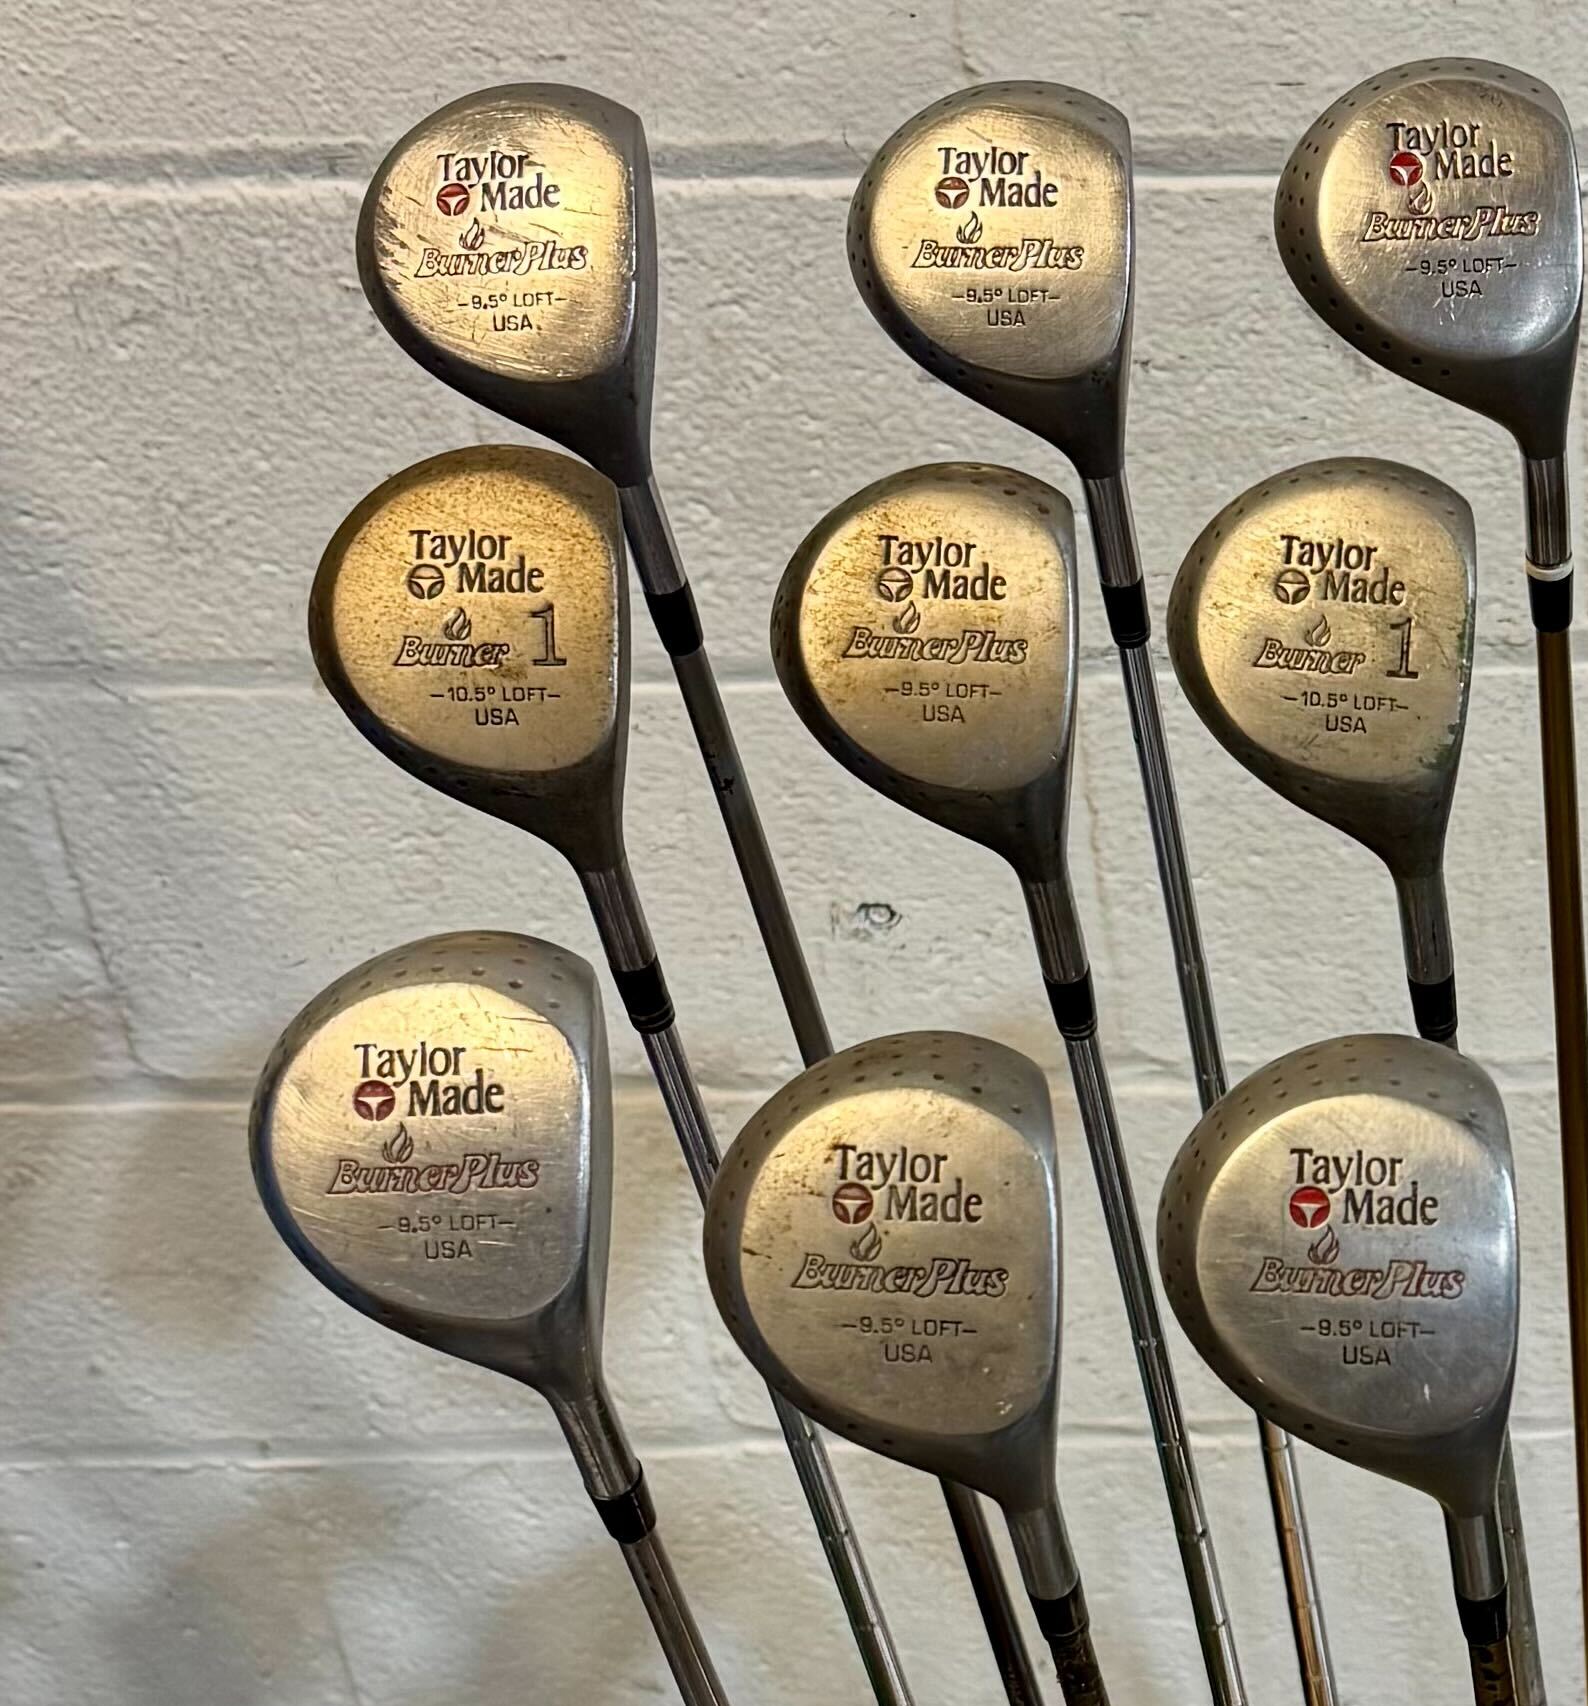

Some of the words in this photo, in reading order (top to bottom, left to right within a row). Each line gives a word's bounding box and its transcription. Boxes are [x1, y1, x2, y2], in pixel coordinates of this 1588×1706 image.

[1386, 120, 1480, 156] Taylor
[437, 150, 529, 188] Taylor
[938, 146, 1030, 182] Taylor
[1434, 139, 1513, 180] Made
[480, 173, 560, 212] Made
[979, 170, 1058, 207] Made
[1441, 281, 1482, 298] USA
[493, 314, 532, 331] USA
[987, 309, 1025, 327] USA
[408, 529, 512, 568] Taylor
[878, 535, 976, 574] Taylor
[1280, 535, 1378, 575] Taylor
[457, 555, 545, 593] Made
[922, 562, 1007, 601] Made
[1322, 567, 1406, 606] Made
[393, 635, 511, 668] Burner
[530, 602, 567, 666] 1
[1252, 638, 1366, 674] Burner
[1388, 616, 1419, 680] 1
[474, 708, 520, 726] USA
[922, 704, 966, 723] USA
[1325, 716, 1367, 734] USA
[354, 1041, 467, 1088] Taylor
[407, 1067, 504, 1117] Made
[832, 1144, 948, 1191] Taylor
[1289, 1148, 1404, 1195] Taylor
[885, 1178, 984, 1223] Made
[1342, 1181, 1439, 1226] Made
[424, 1240, 473, 1260] USA
[883, 1344, 933, 1363] USA
[1342, 1345, 1392, 1366] USA
